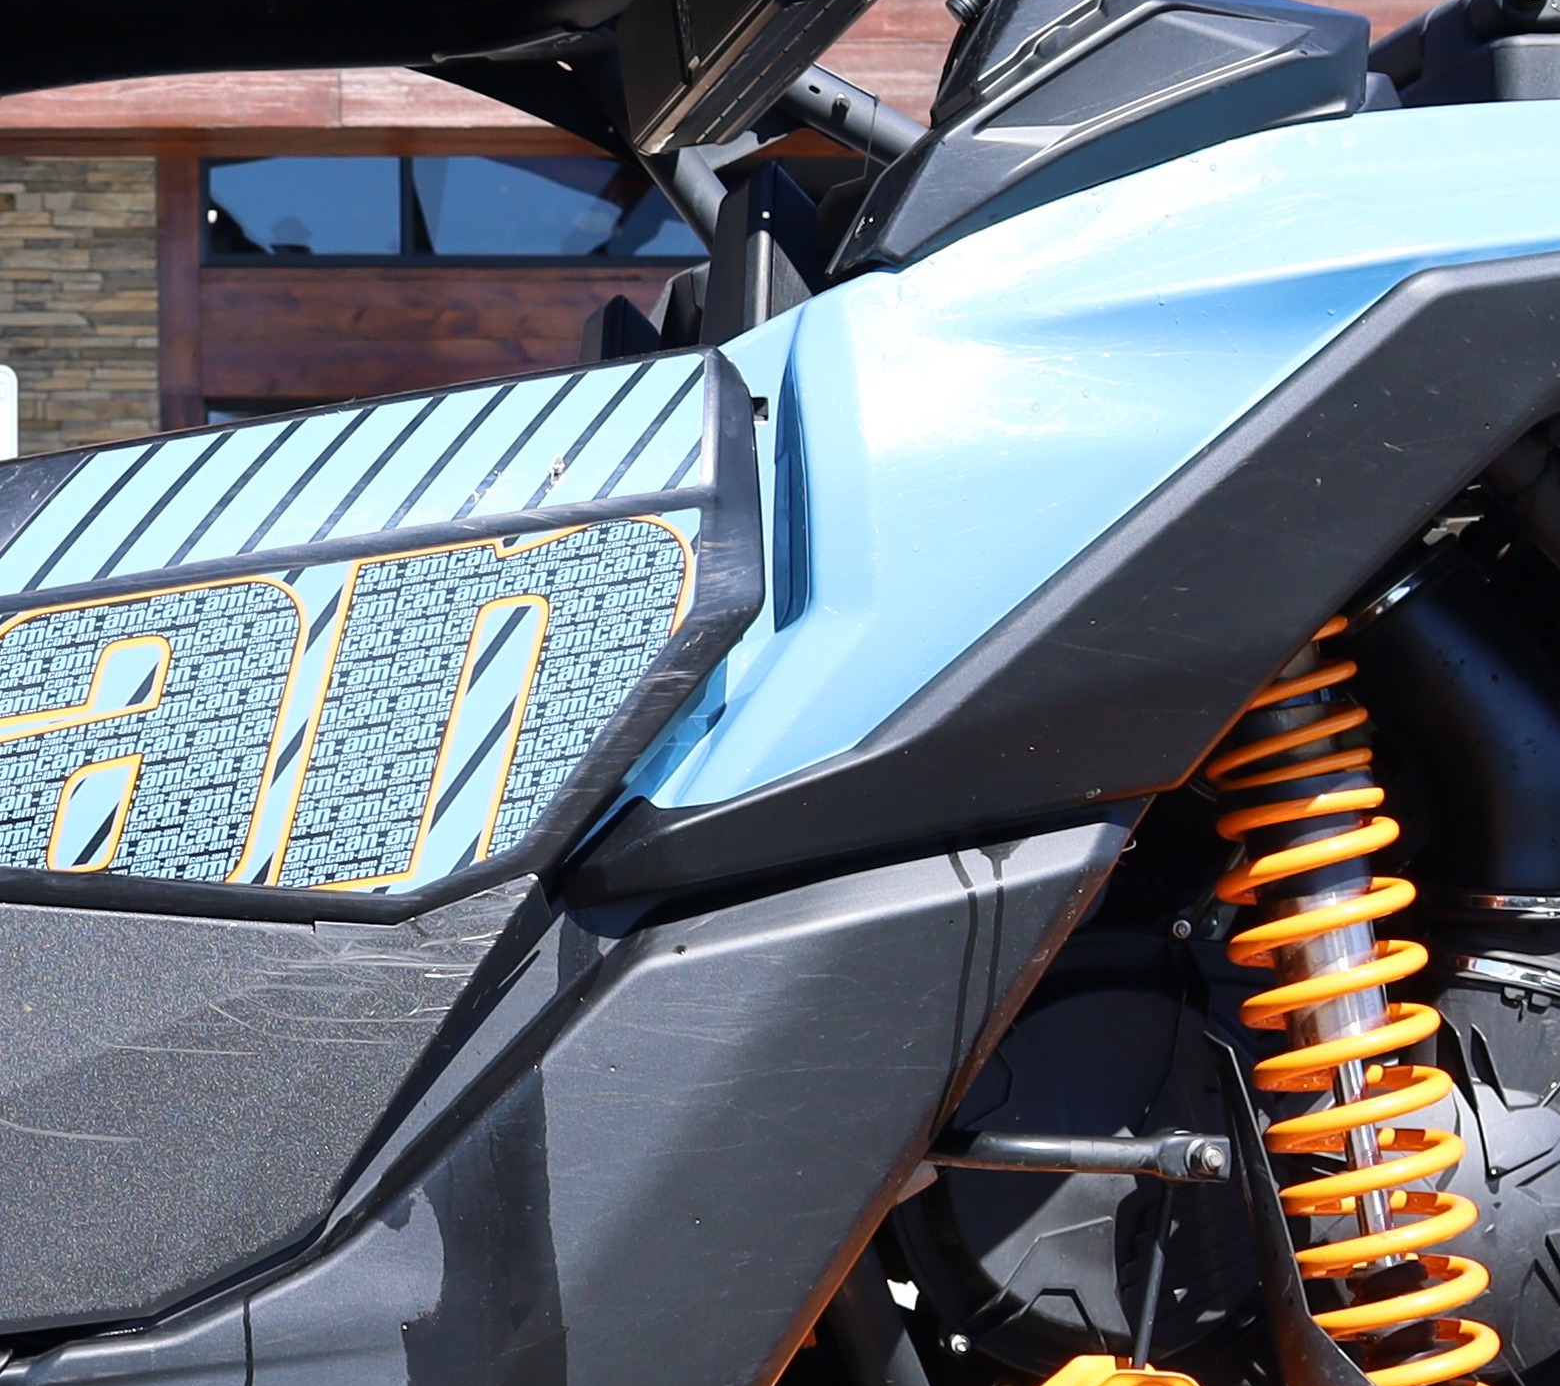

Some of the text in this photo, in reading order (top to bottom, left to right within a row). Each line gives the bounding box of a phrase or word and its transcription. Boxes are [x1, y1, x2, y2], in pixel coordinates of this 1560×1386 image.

[400, 578, 458, 595] can-am
[499, 560, 559, 577] can-am
[599, 541, 659, 559] can-am
[396, 563, 597, 612] can-am can-am
[548, 584, 608, 602] can-am
[48, 605, 109, 623] can-am
[150, 588, 208, 605] can-am
[543, 588, 646, 618] can-am
[44, 592, 245, 640] can-am can-am
[197, 612, 256, 630] can-am
[595, 608, 655, 626] can-am
[192, 616, 294, 646] can-am
[341, 622, 442, 653] can-am
[395, 644, 454, 661] can-am
[544, 651, 603, 668] can-am
[540, 654, 641, 684] can-am
[191, 678, 252, 696] can-am
[342, 686, 401, 703] can-am
[187, 683, 290, 713] can-am
[337, 690, 438, 720] can-am
[389, 711, 449, 728] can-am
[539, 717, 598, 735] can-am
[138, 721, 198, 738] can-am
[33, 742, 135, 773] can-am
[135, 725, 235, 755] can-am
[37, 739, 98, 756] can-am
[186, 746, 246, 763] can-am
[336, 753, 396, 770] can-am
[332, 757, 433, 787] can-am
[133, 789, 193, 806] can-am
[129, 793, 230, 823] can-am
[181, 813, 241, 830] can-am
[331, 821, 390, 838] can-am
[128, 855, 188, 872] can-am
[277, 863, 337, 880] can-am
